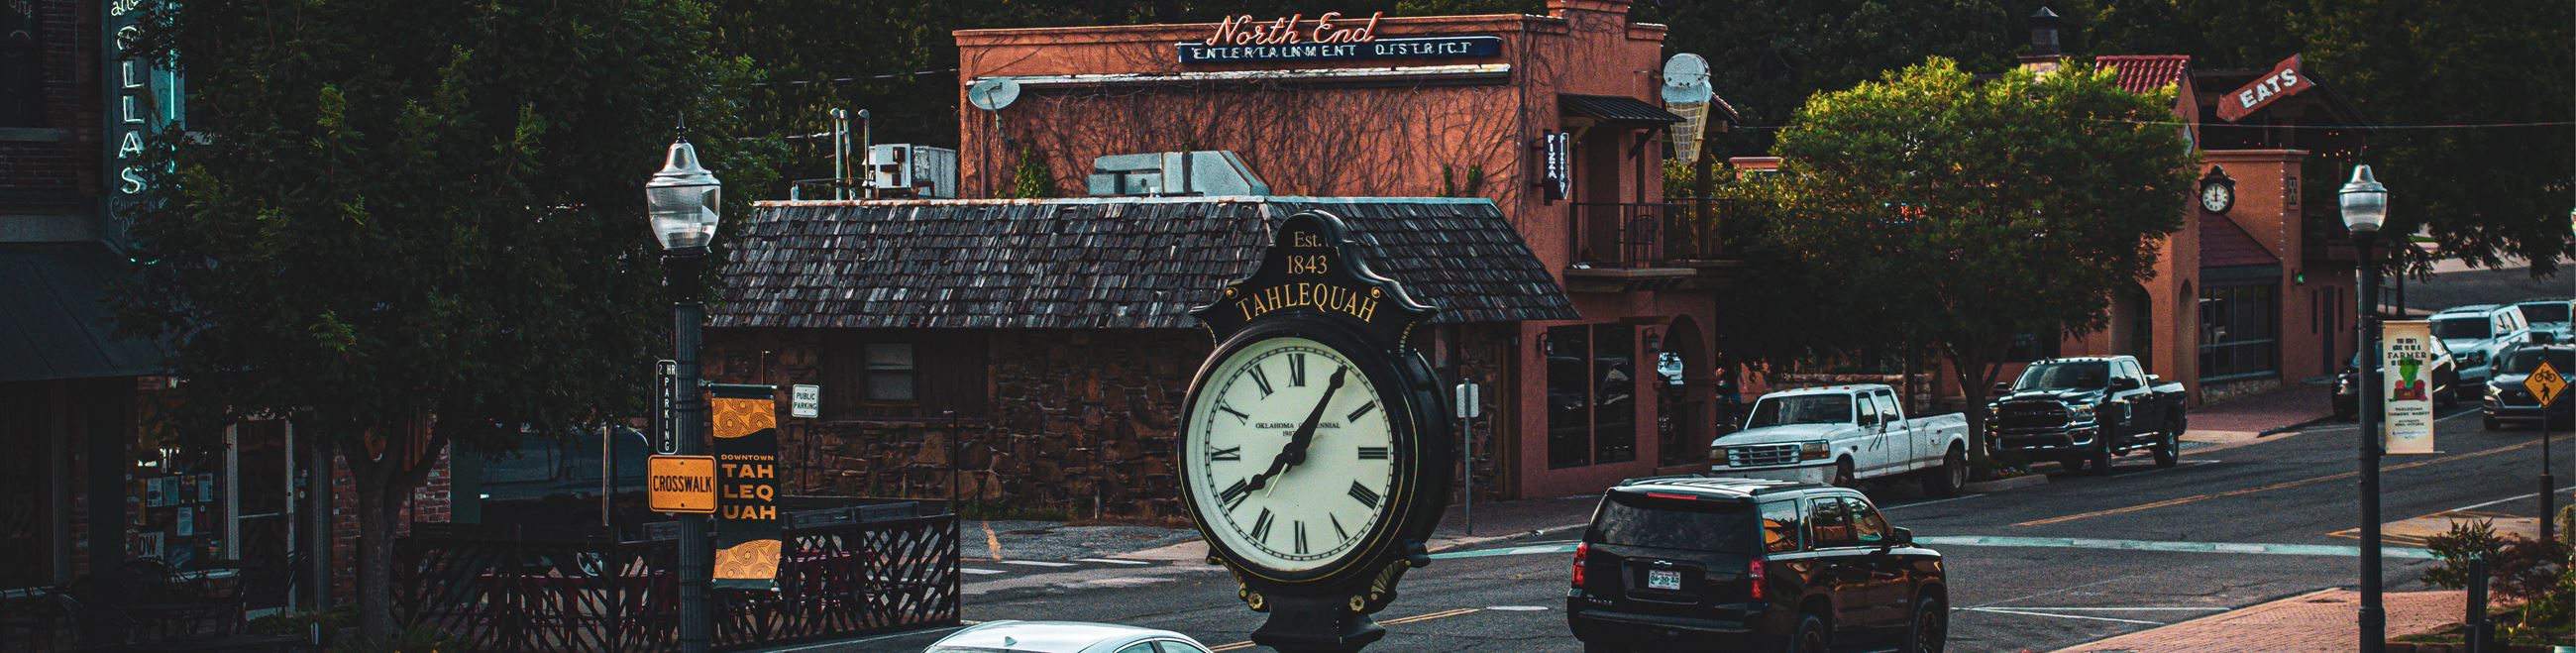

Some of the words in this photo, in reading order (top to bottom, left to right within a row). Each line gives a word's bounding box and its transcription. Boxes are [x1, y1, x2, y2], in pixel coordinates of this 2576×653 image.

[1206, 13, 1302, 47] North
[1312, 11, 1384, 44] End
[1192, 45, 1356, 59] ENTERTAINMENT
[1375, 42, 1472, 55] DISTRICT
[2238, 68, 2298, 109] EATS
[1547, 134, 1557, 179] PIZZA
[1293, 231, 1322, 248] Est.
[1287, 255, 1328, 274] 1843
[1235, 282, 1378, 323] TAHLEQUAH
[658, 364, 663, 376] 2
[667, 364, 676, 376] HR
[1287, 353, 1306, 387] XII
[796, 392, 815, 401] PUBLIC
[794, 401, 817, 410] PARKING
[721, 463, 774, 479] TAH
[653, 475, 712, 493] CROSSWALK
[723, 484, 774, 501] LEQ
[722, 504, 777, 520] UAH
